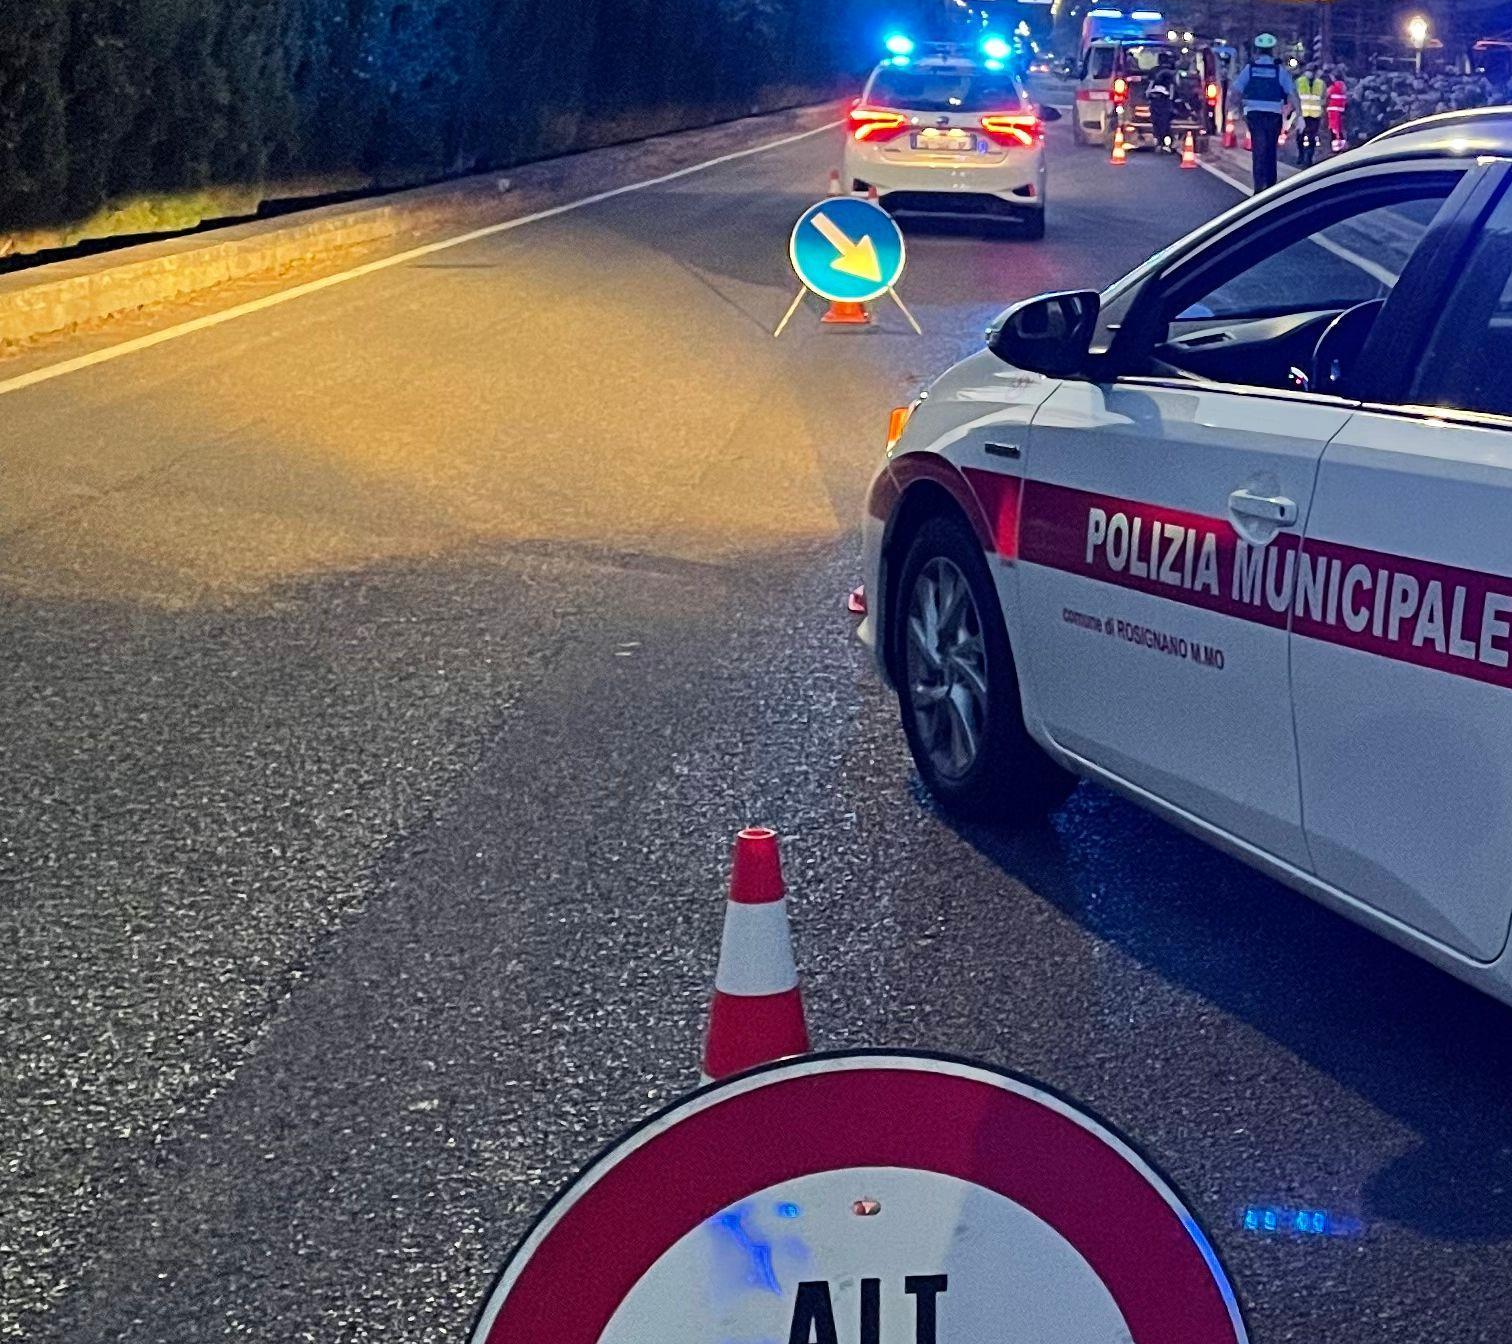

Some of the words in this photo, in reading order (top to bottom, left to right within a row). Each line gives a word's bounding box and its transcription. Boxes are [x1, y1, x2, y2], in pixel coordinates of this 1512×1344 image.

[1086, 507, 1220, 595] POLIZIA
[1062, 607, 1102, 633] comune
[1104, 617, 1115, 635] di
[1117, 620, 1188, 658] ROSIGNANO
[1190, 642, 1225, 670] M.MO
